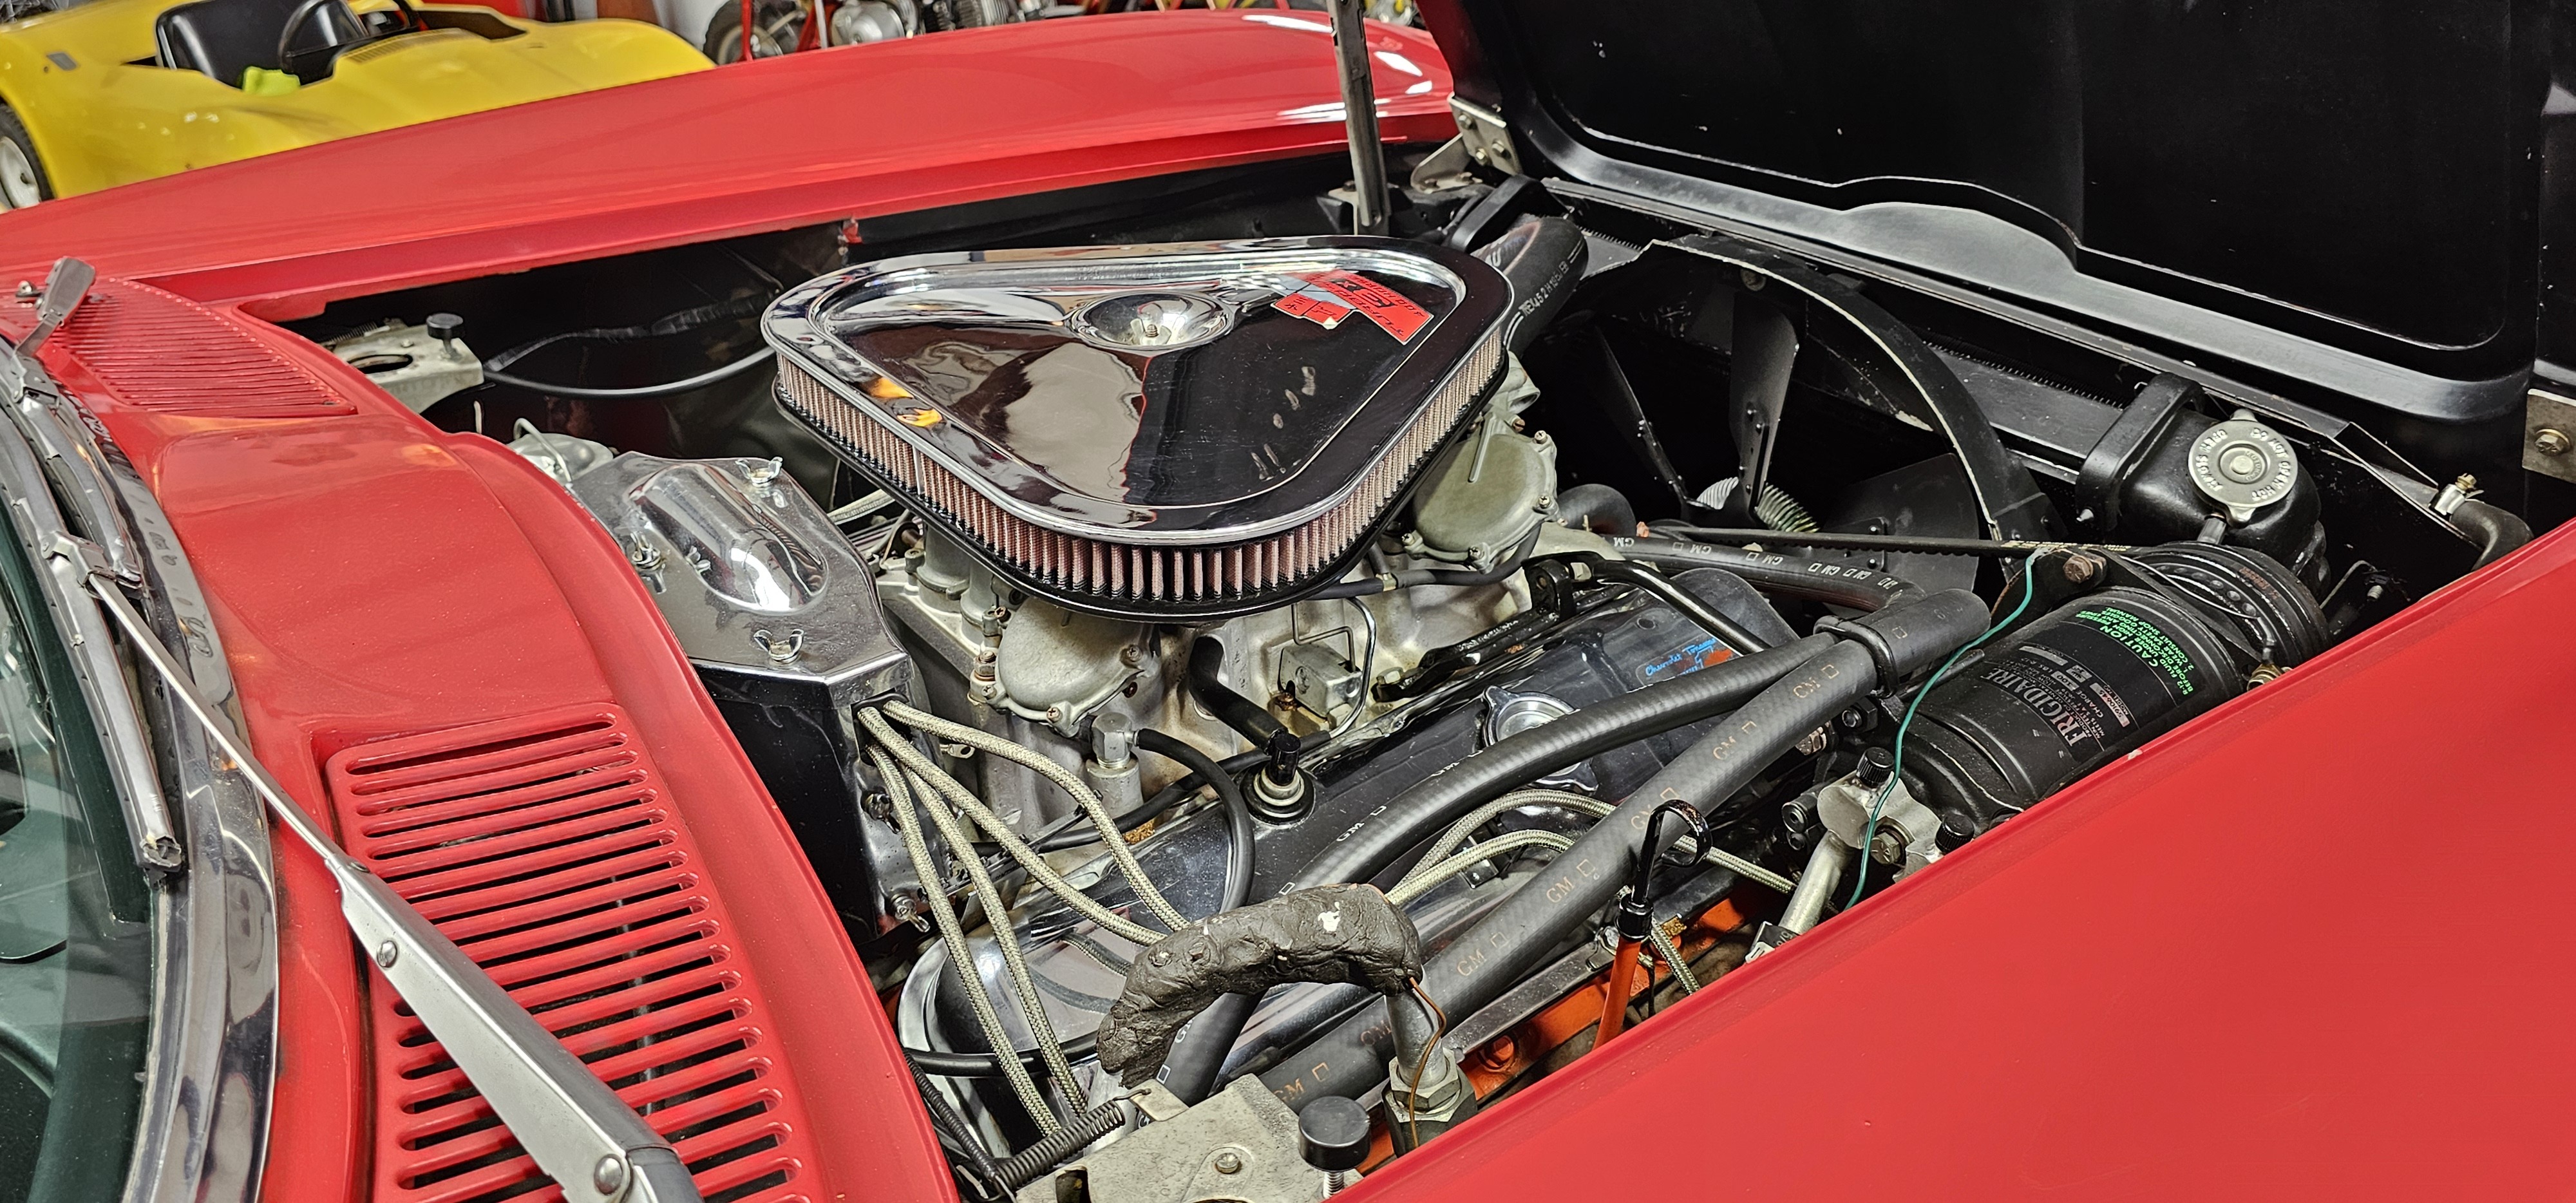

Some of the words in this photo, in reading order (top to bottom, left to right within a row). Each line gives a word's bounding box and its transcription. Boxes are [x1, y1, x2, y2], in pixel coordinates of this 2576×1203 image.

[1613, 537, 1634, 547] GM
[1689, 544, 1712, 554] GM
[1762, 553, 1784, 565] GM
[2137, 627, 2163, 645] SAFETY
[2138, 621, 2159, 635] SHOP
[2099, 626, 2157, 668] CAUTION
[2119, 622, 2174, 663] DISCONNECTING
[2134, 637, 2157, 657] UNDER
[2159, 636, 2188, 663] CONSULT
[2163, 646, 2183, 666] WEAR
[2159, 659, 2177, 677] FLUID
[2172, 665, 2193, 692] BEFORE
[1794, 677, 1821, 698] GM
[2177, 680, 2188, 695] R-12
[1980, 668, 2088, 747] FRIGIDAIRE
[2076, 690, 2103, 717] CHARGE
[2099, 690, 2123, 717] 5910645
[2113, 696, 2129, 715] MODEL
[2070, 712, 2092, 737] PRODUCT
[1712, 735, 1737, 760] GM
[1336, 821, 1365, 842] GM
[1546, 876, 1575, 903] GM
[1457, 948, 1488, 976] GM
